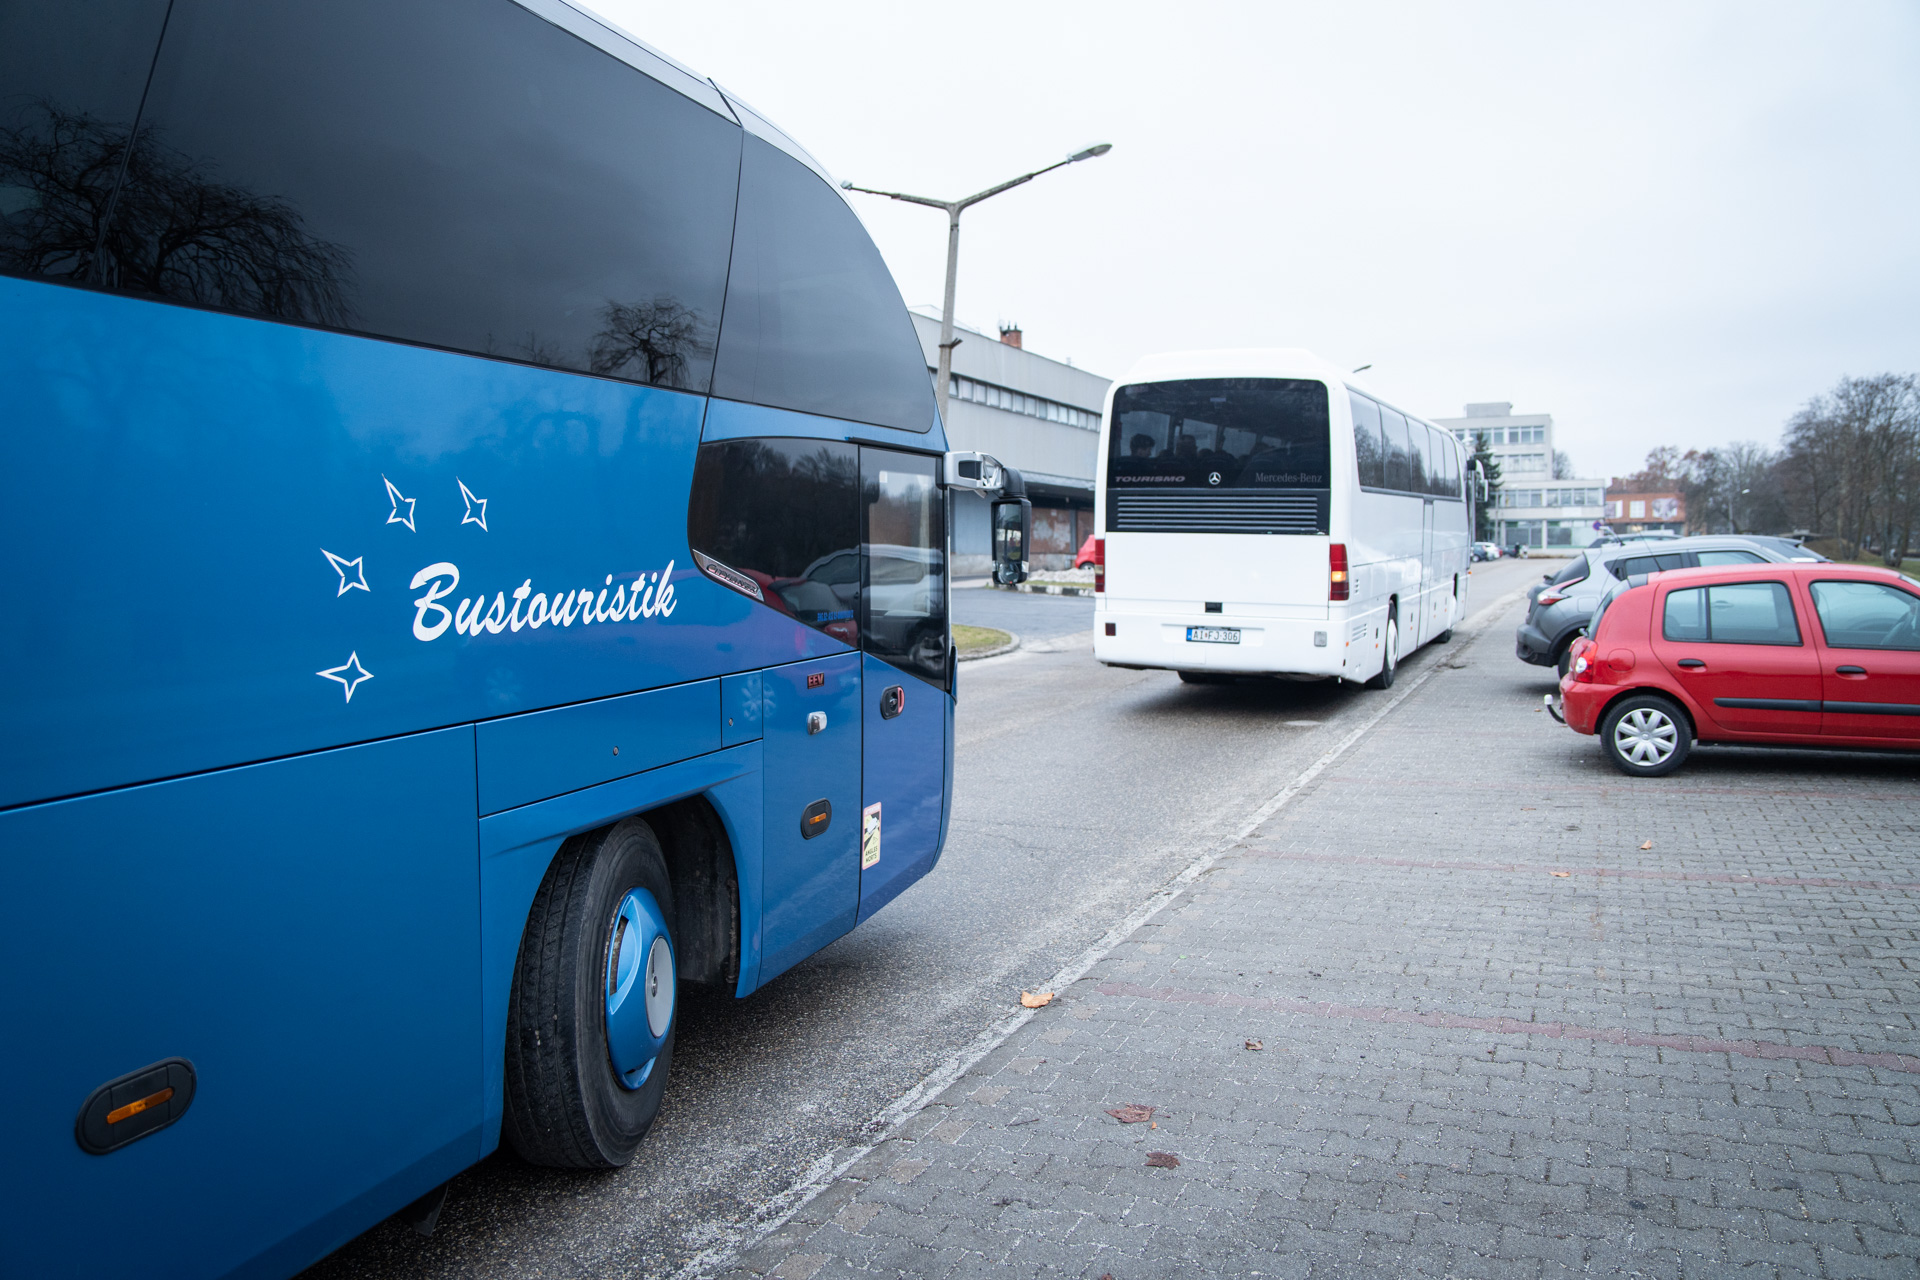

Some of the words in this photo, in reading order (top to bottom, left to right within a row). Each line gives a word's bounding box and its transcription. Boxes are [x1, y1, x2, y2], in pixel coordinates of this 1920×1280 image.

[1114, 475, 1186, 483] TOURISMO
[1254, 472, 1323, 484] Mercedes-Benz
[409, 559, 678, 642] Bustouristik
[808, 673, 824, 687] EEV
[865, 845, 878, 857] ANGLES
[865, 852, 878, 863] MORTS
